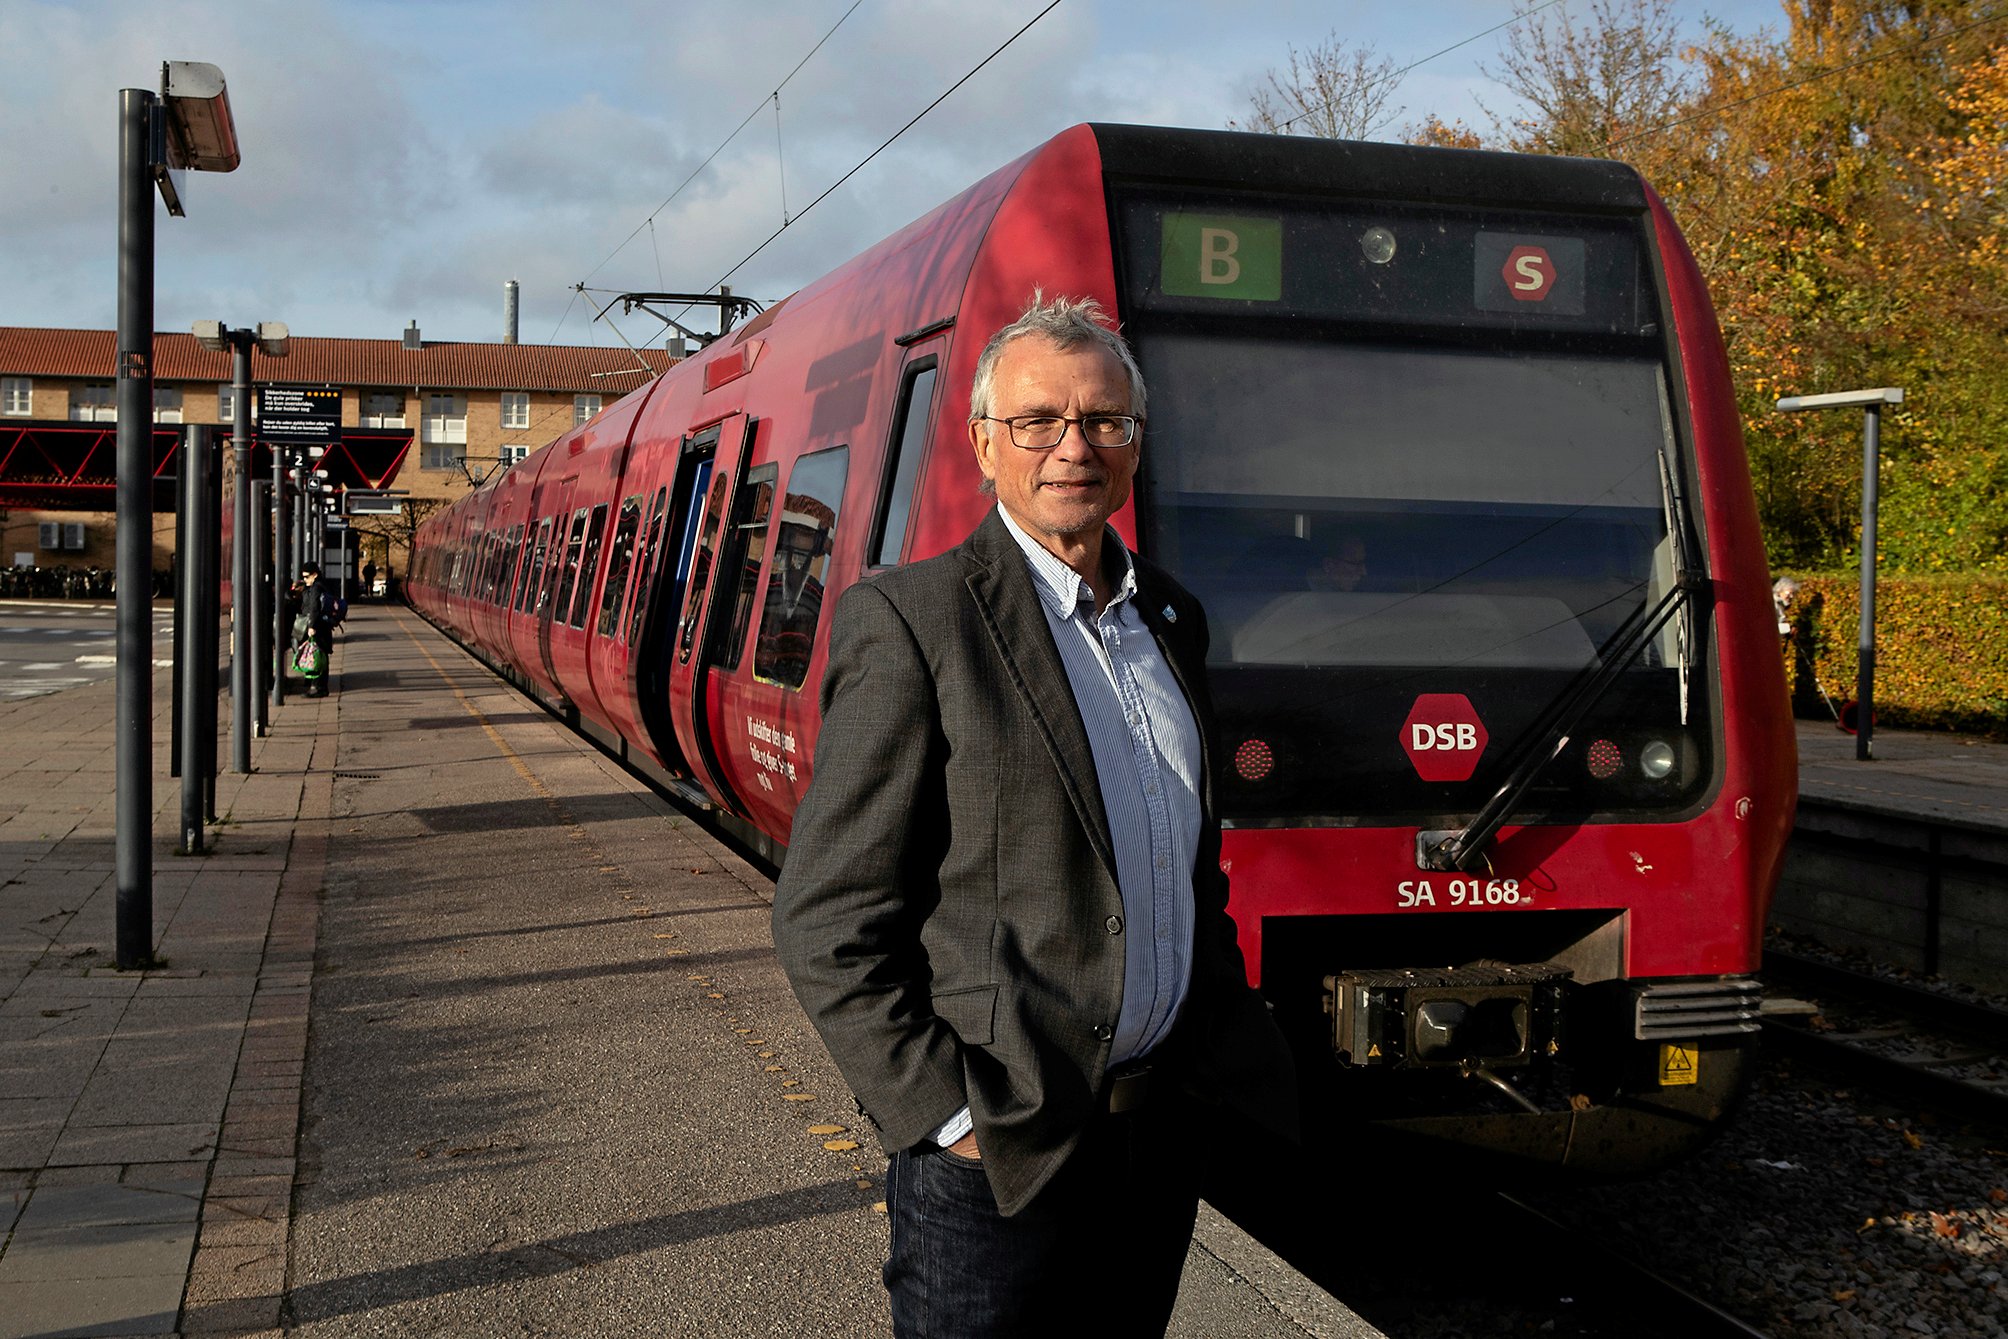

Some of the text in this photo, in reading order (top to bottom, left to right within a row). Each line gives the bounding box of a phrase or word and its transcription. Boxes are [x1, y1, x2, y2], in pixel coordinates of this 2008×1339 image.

[1201, 217, 1241, 286] B
[1514, 255, 1545, 291] S
[294, 456, 303, 466] 2
[1411, 723, 1478, 751] DSB
[1398, 878, 1520, 908] SA 9168
